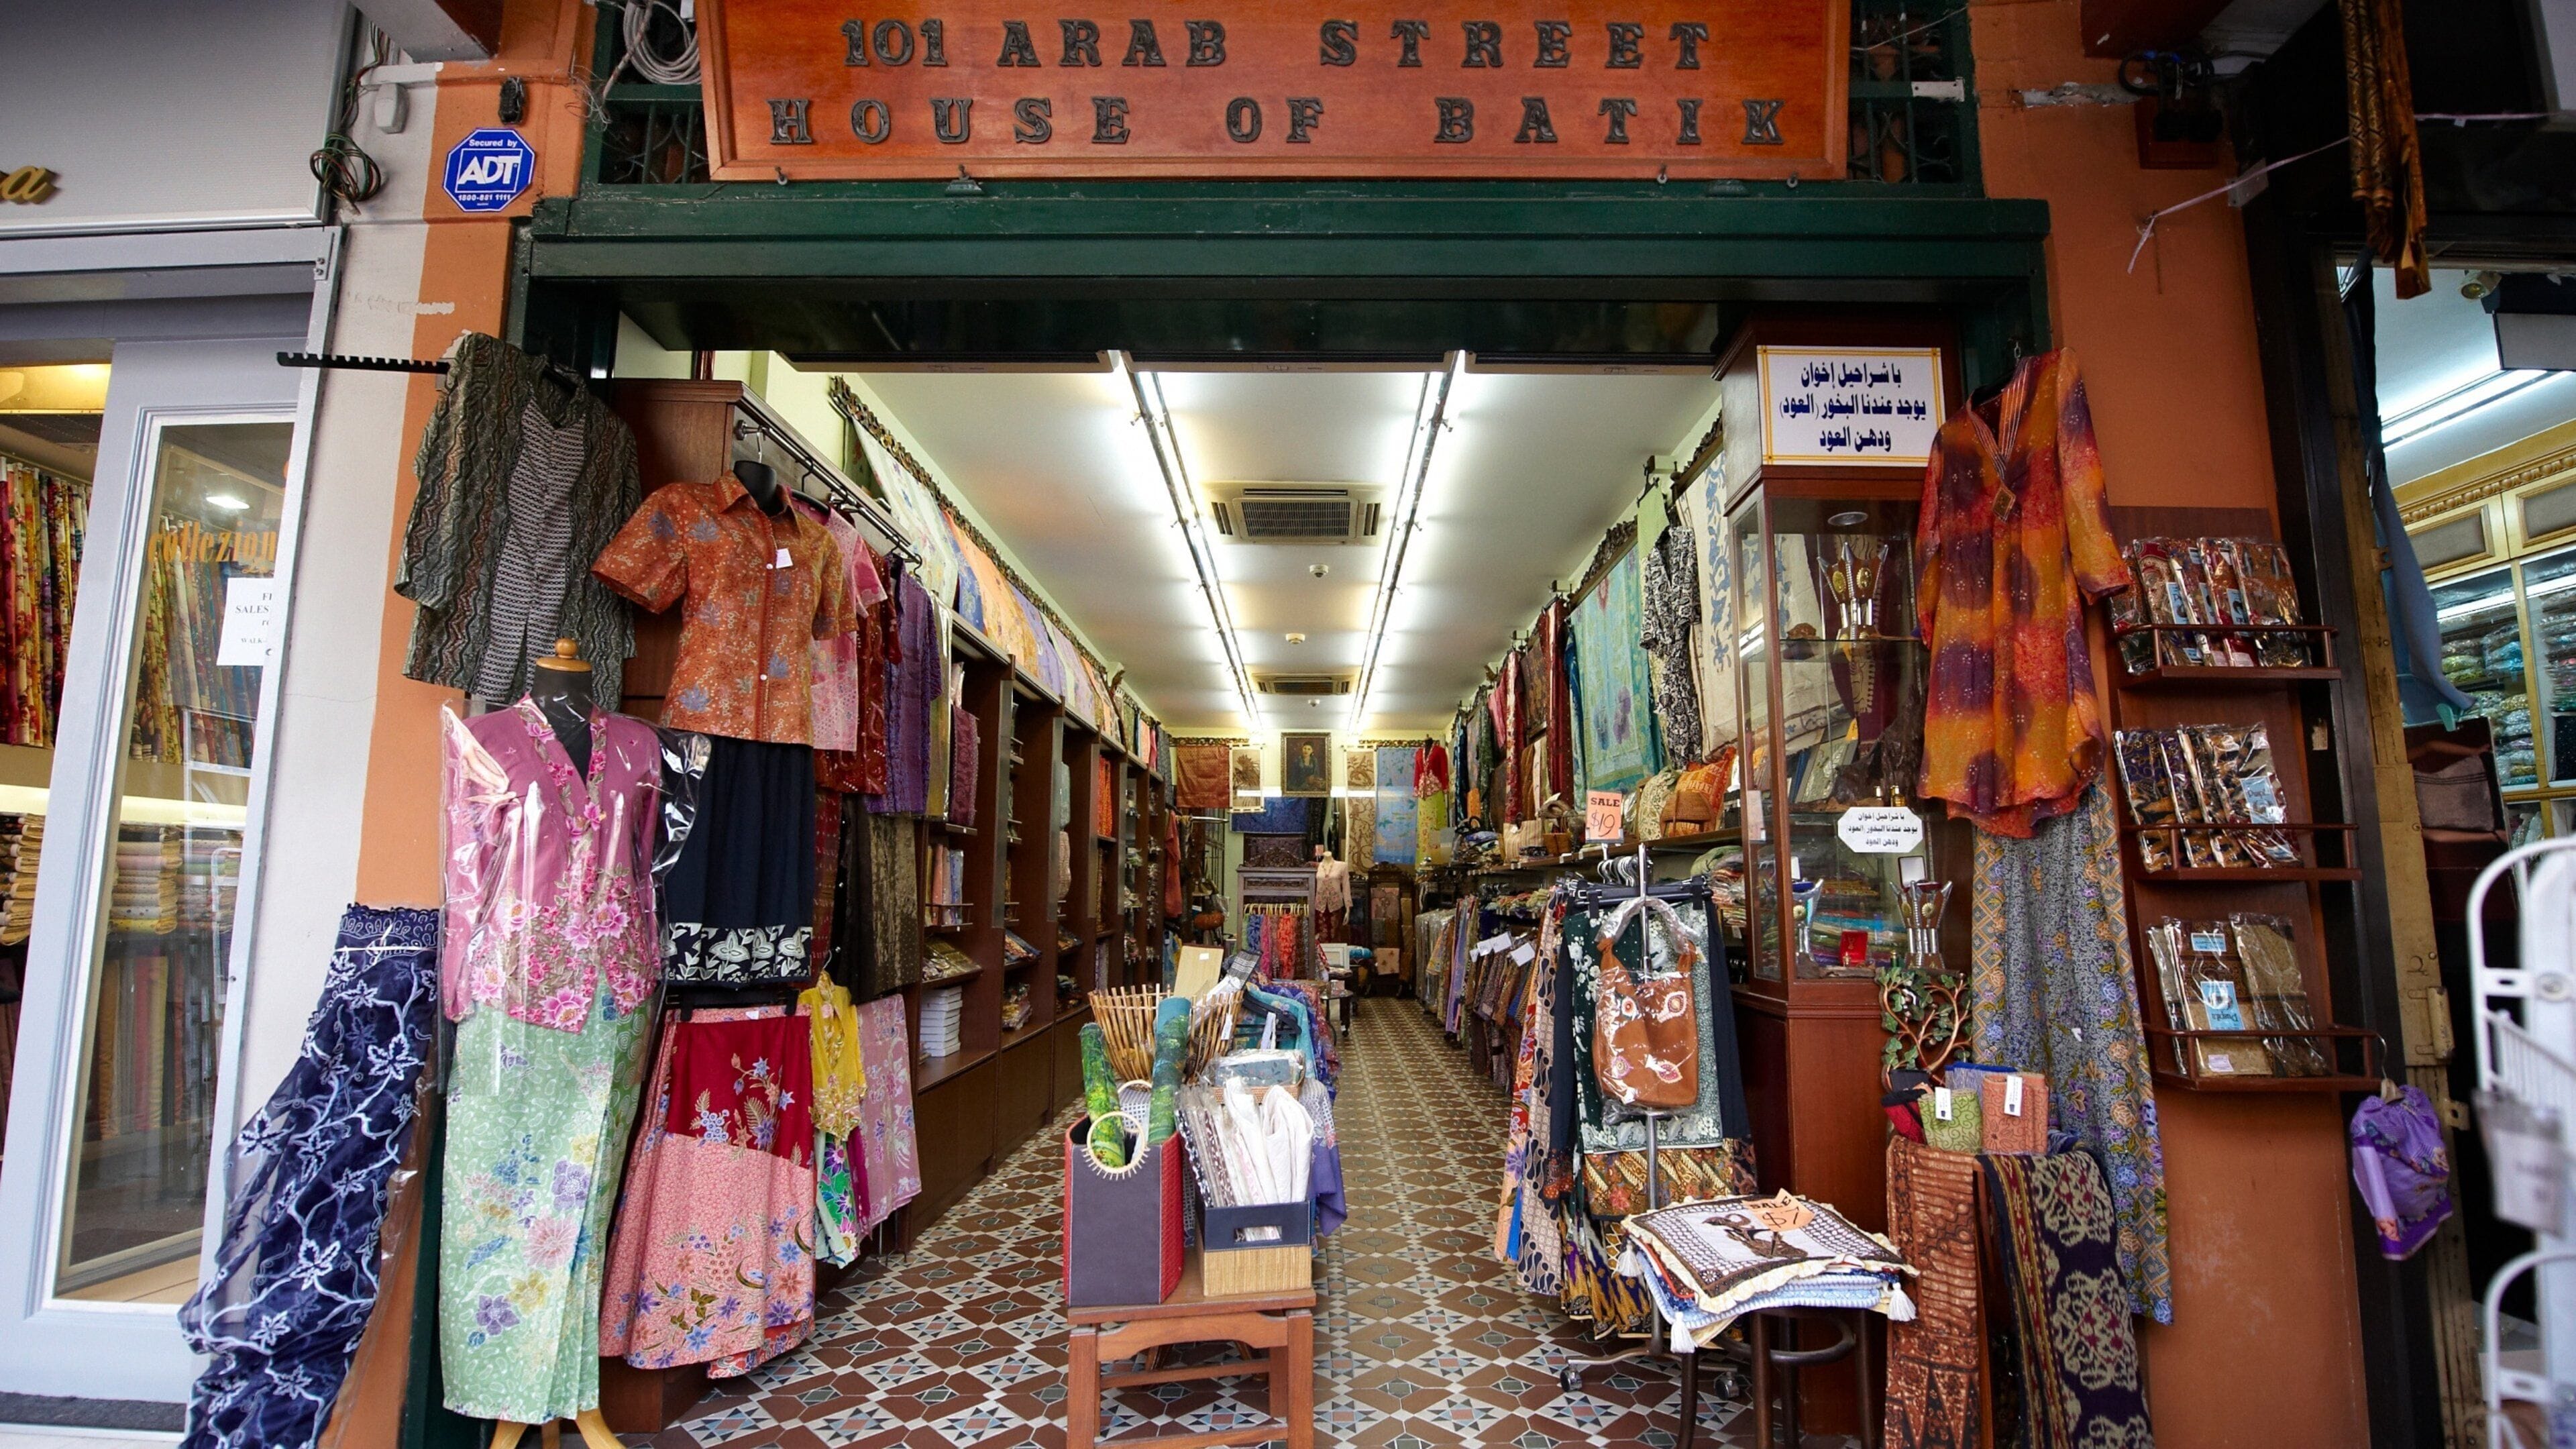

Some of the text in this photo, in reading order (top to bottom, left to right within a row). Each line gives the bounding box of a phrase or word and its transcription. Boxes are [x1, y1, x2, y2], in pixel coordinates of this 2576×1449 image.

[841, 18, 1709, 69] 101 ARAB STREET
[766, 96, 1785, 144] HOUSE OF BATIK
[469, 139, 517, 148] Secured by
[458, 155, 521, 184] ADT
[1801, 361, 1835, 389] إخوان
[1821, 392, 1859, 419] البخور
[1861, 393, 1892, 415] عندنا
[1896, 398, 1926, 421] يوجد
[1819, 425, 1891, 452] ودهن العود
[235, 604, 269, 613] SALES
[1591, 797, 1620, 808] SALE
[1591, 810, 1615, 837] $19
